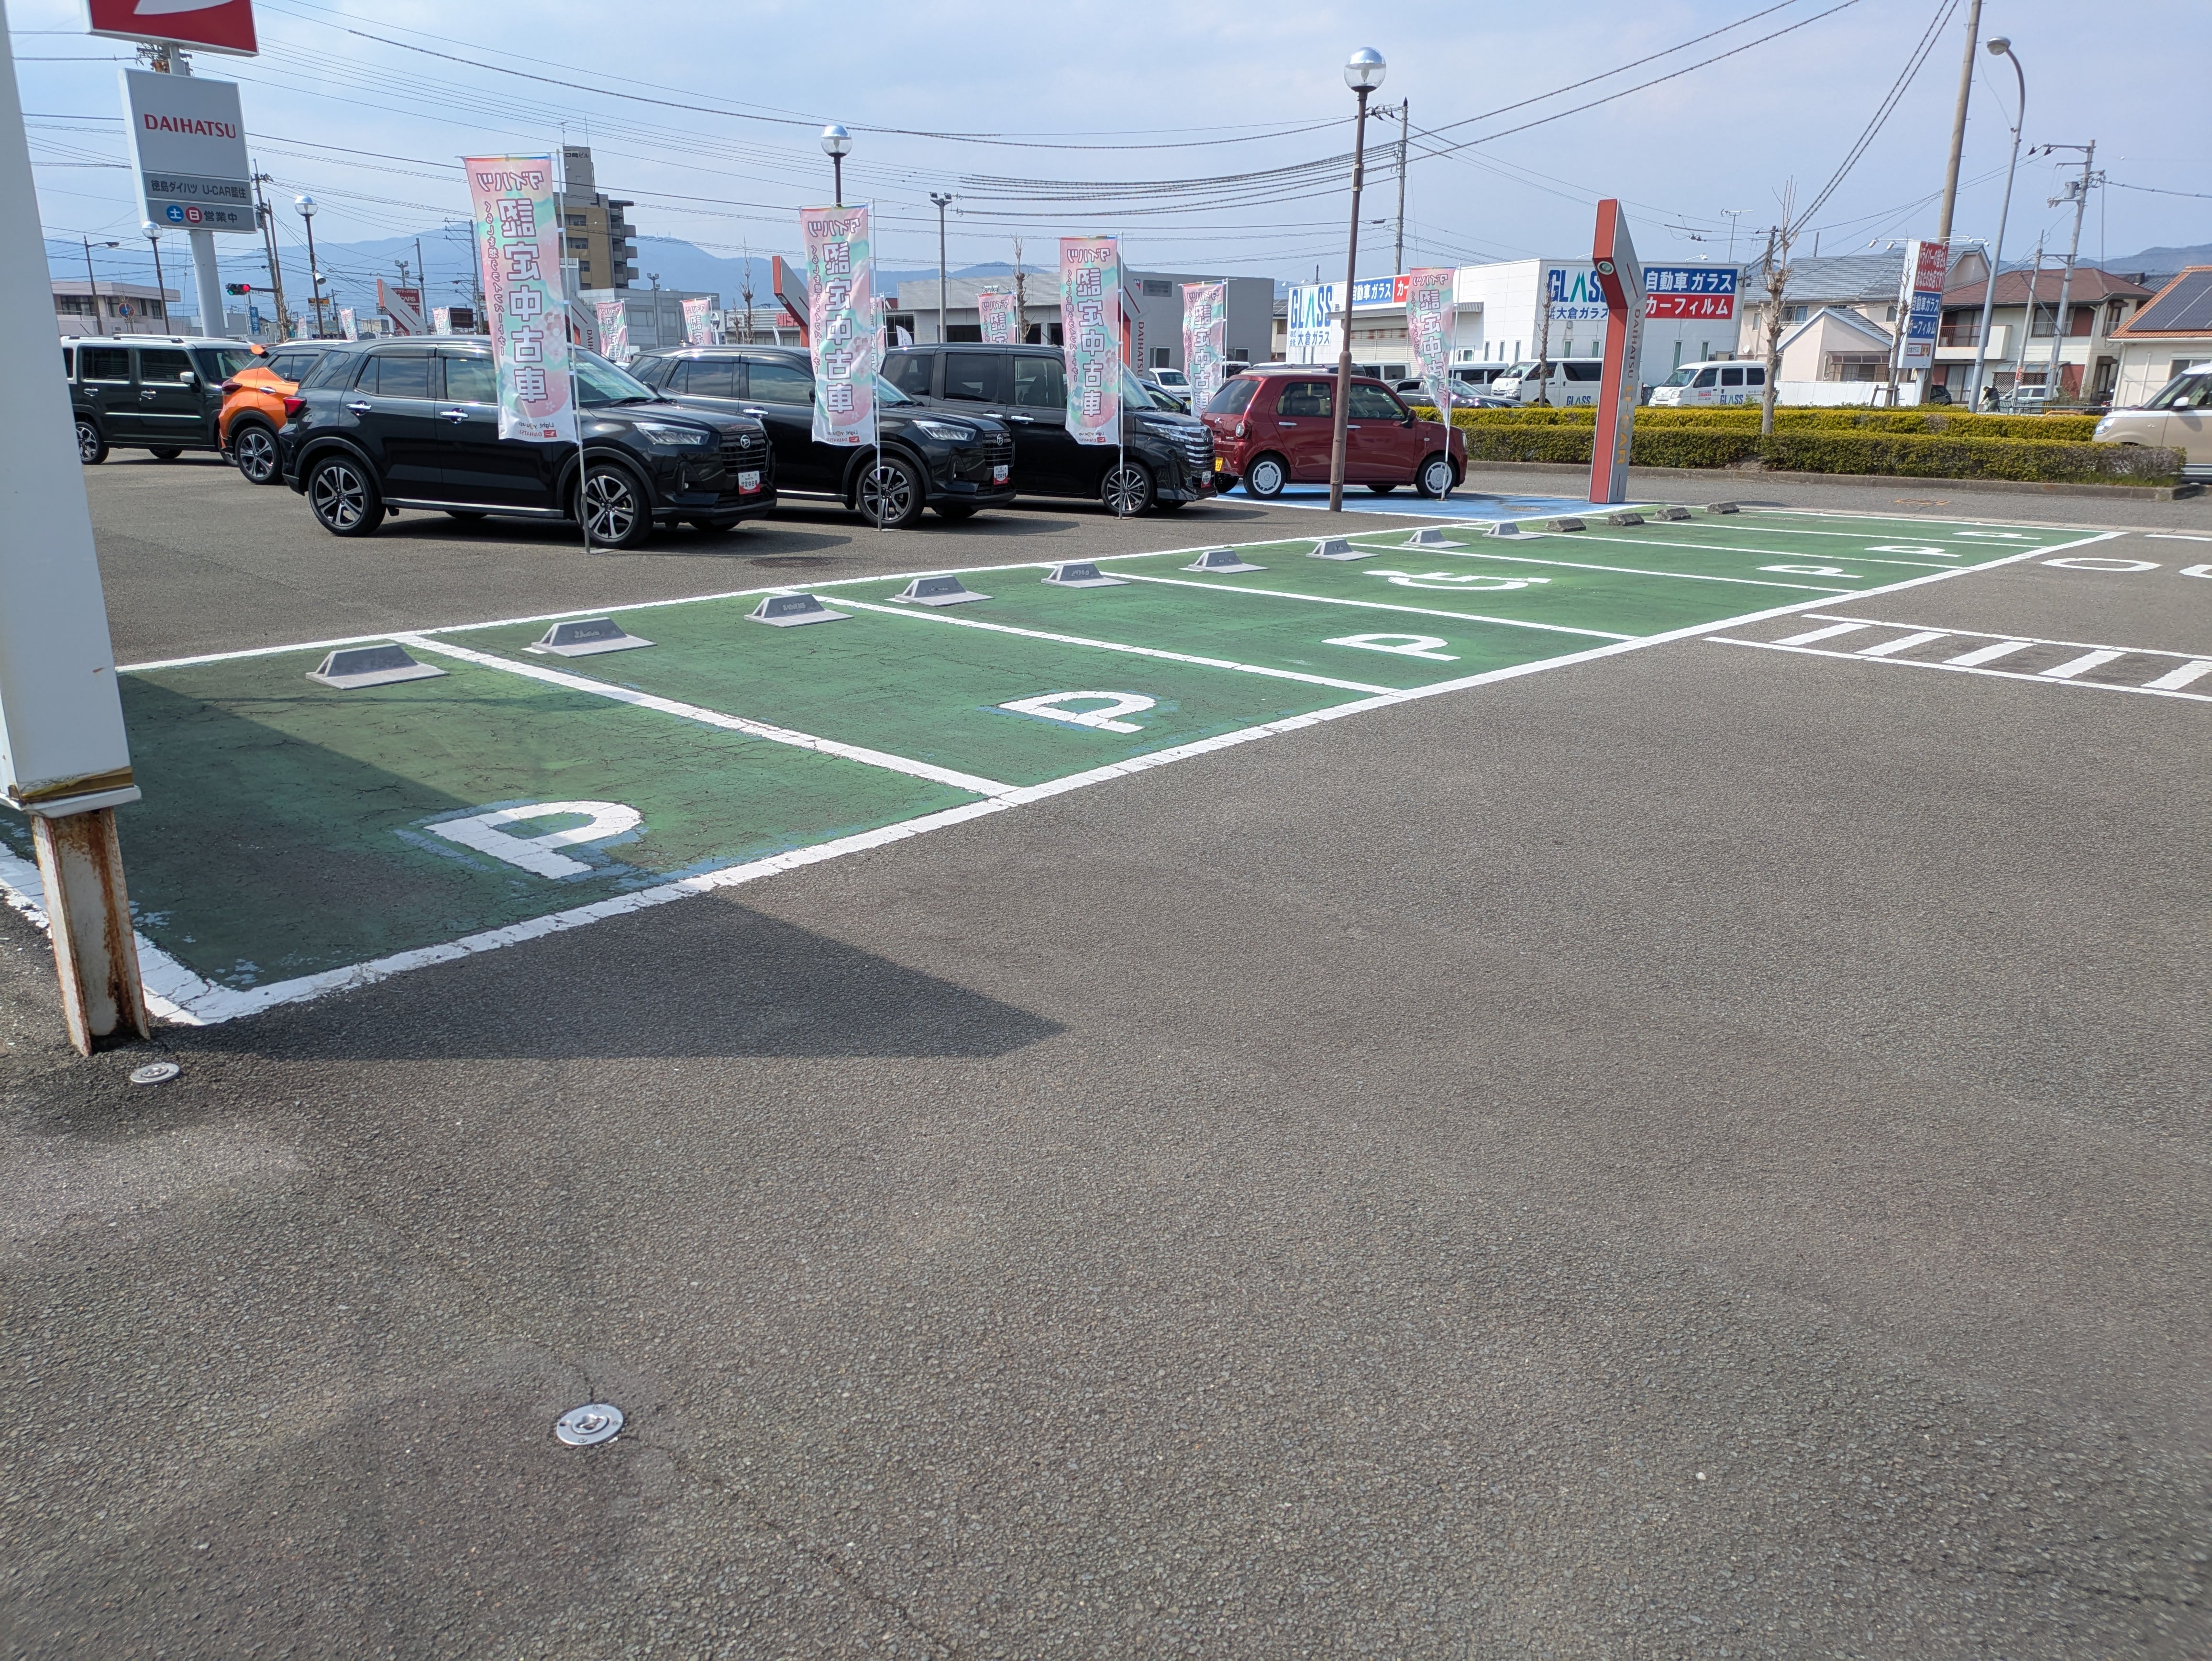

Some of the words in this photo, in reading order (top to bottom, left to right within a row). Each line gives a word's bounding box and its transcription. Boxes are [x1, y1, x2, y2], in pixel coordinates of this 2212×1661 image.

[144, 114, 236, 138] DAIHATSU
[151, 180, 198, 194] 徳島ダイハツ
[203, 184, 246, 199] U-CAR藍住
[1646, 271, 1732, 291] 自動車ガラス
[1353, 283, 1391, 301] 自動車ガラス
[1291, 286, 1333, 329] GLASS
[1557, 307, 1609, 319] 大倉ガラス
[1646, 296, 1728, 315] カーフィルム
[1912, 296, 1939, 312] 自動車ガラス
[1298, 331, 1330, 345] 大倉ガラス
[1628, 309, 1640, 378] DAIHATSU
[1566, 396, 1591, 406] GLASS
[1720, 395, 1744, 405] GLASS
[1617, 385, 1634, 464] U-CAR
[1864, 545, 1963, 557] P
[1756, 565, 1864, 578] P
[1321, 633, 1461, 661] P
[1000, 691, 1157, 733] P
[424, 801, 642, 879] P
